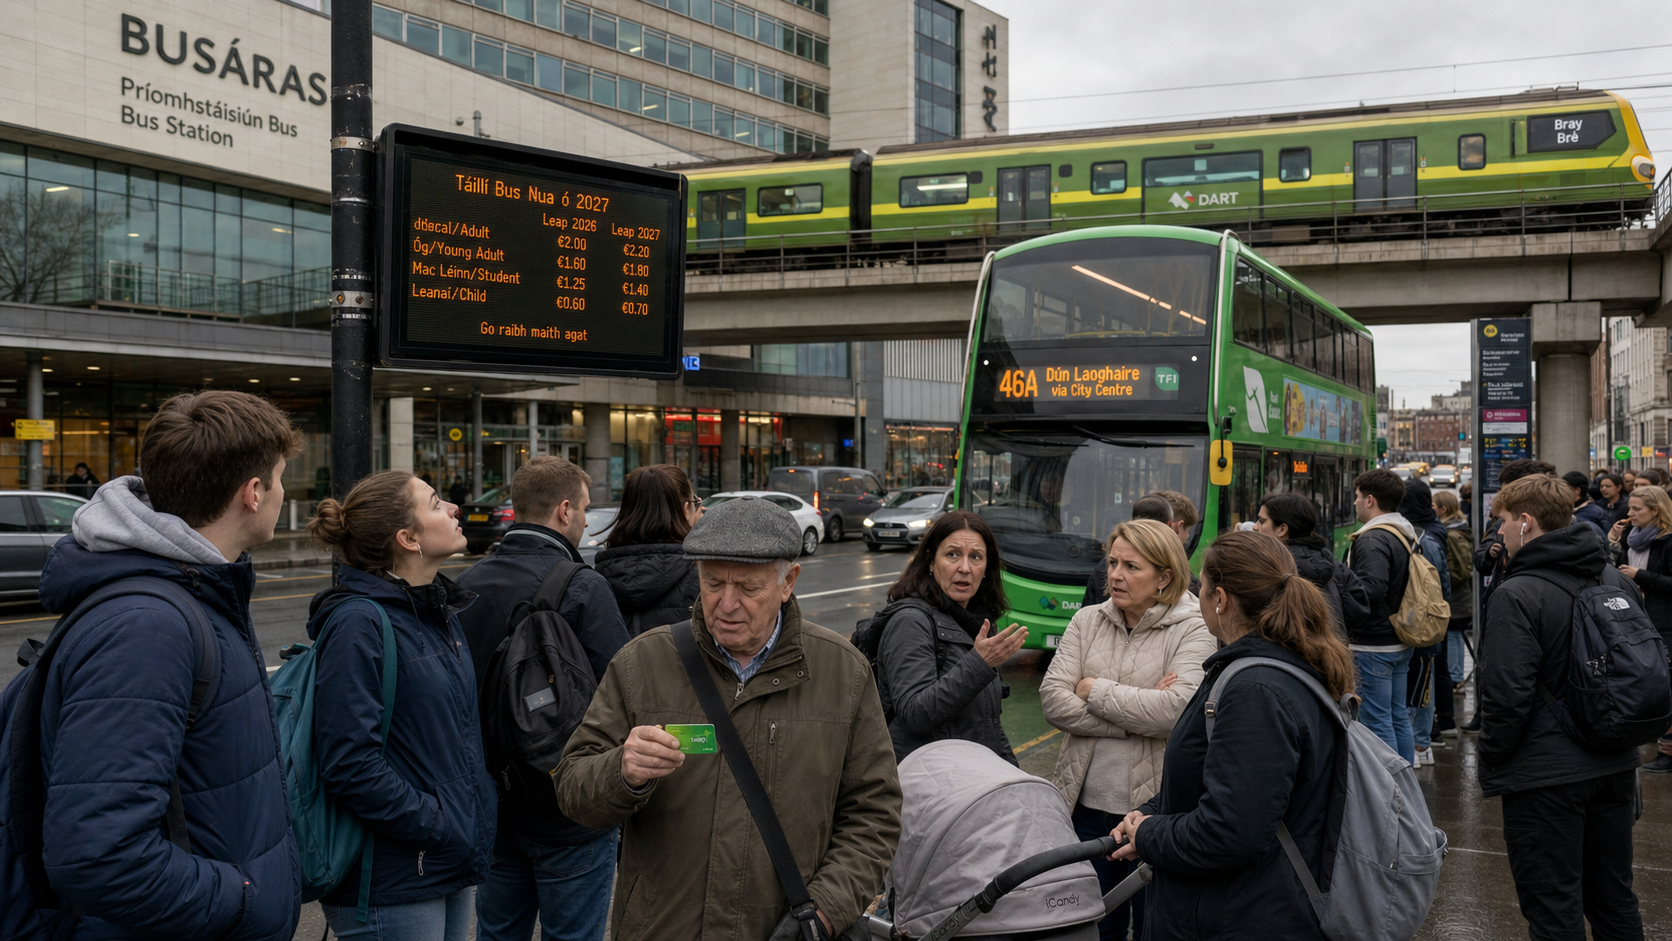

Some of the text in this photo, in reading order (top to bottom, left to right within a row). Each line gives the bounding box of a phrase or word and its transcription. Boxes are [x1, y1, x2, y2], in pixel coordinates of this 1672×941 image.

[121, 12, 328, 107] BUSÁRAS
[121, 76, 299, 138] Príomhstáisiún Bus
[121, 104, 234, 148] Bus Station
[1554, 119, 1583, 131] Bray
[455, 173, 610, 213] Táillí Bus Nua ó 2027
[1198, 191, 1239, 206] DART
[542, 213, 597, 232] Leap 2026
[611, 222, 661, 241] Leap 2027
[413, 236, 505, 262] Óg/Young Adult
[557, 235, 650, 258] €2.00 €2.20
[412, 260, 521, 285] Mac Léinn/Student
[556, 255, 649, 277] €1.60 €1.80
[556, 275, 649, 297] €1.25 €1.40
[556, 295, 649, 316] €0.60 €0.70
[480, 321, 588, 343] Go raibh maith agat
[999, 369, 1039, 398] 46A
[1046, 365, 1140, 383] Dún Laoghaire
[1158, 373, 1177, 384] TFI
[1051, 383, 1133, 399] via City Centre
[1062, 600, 1082, 610] DAR
[1045, 893, 1080, 909] iCandy
